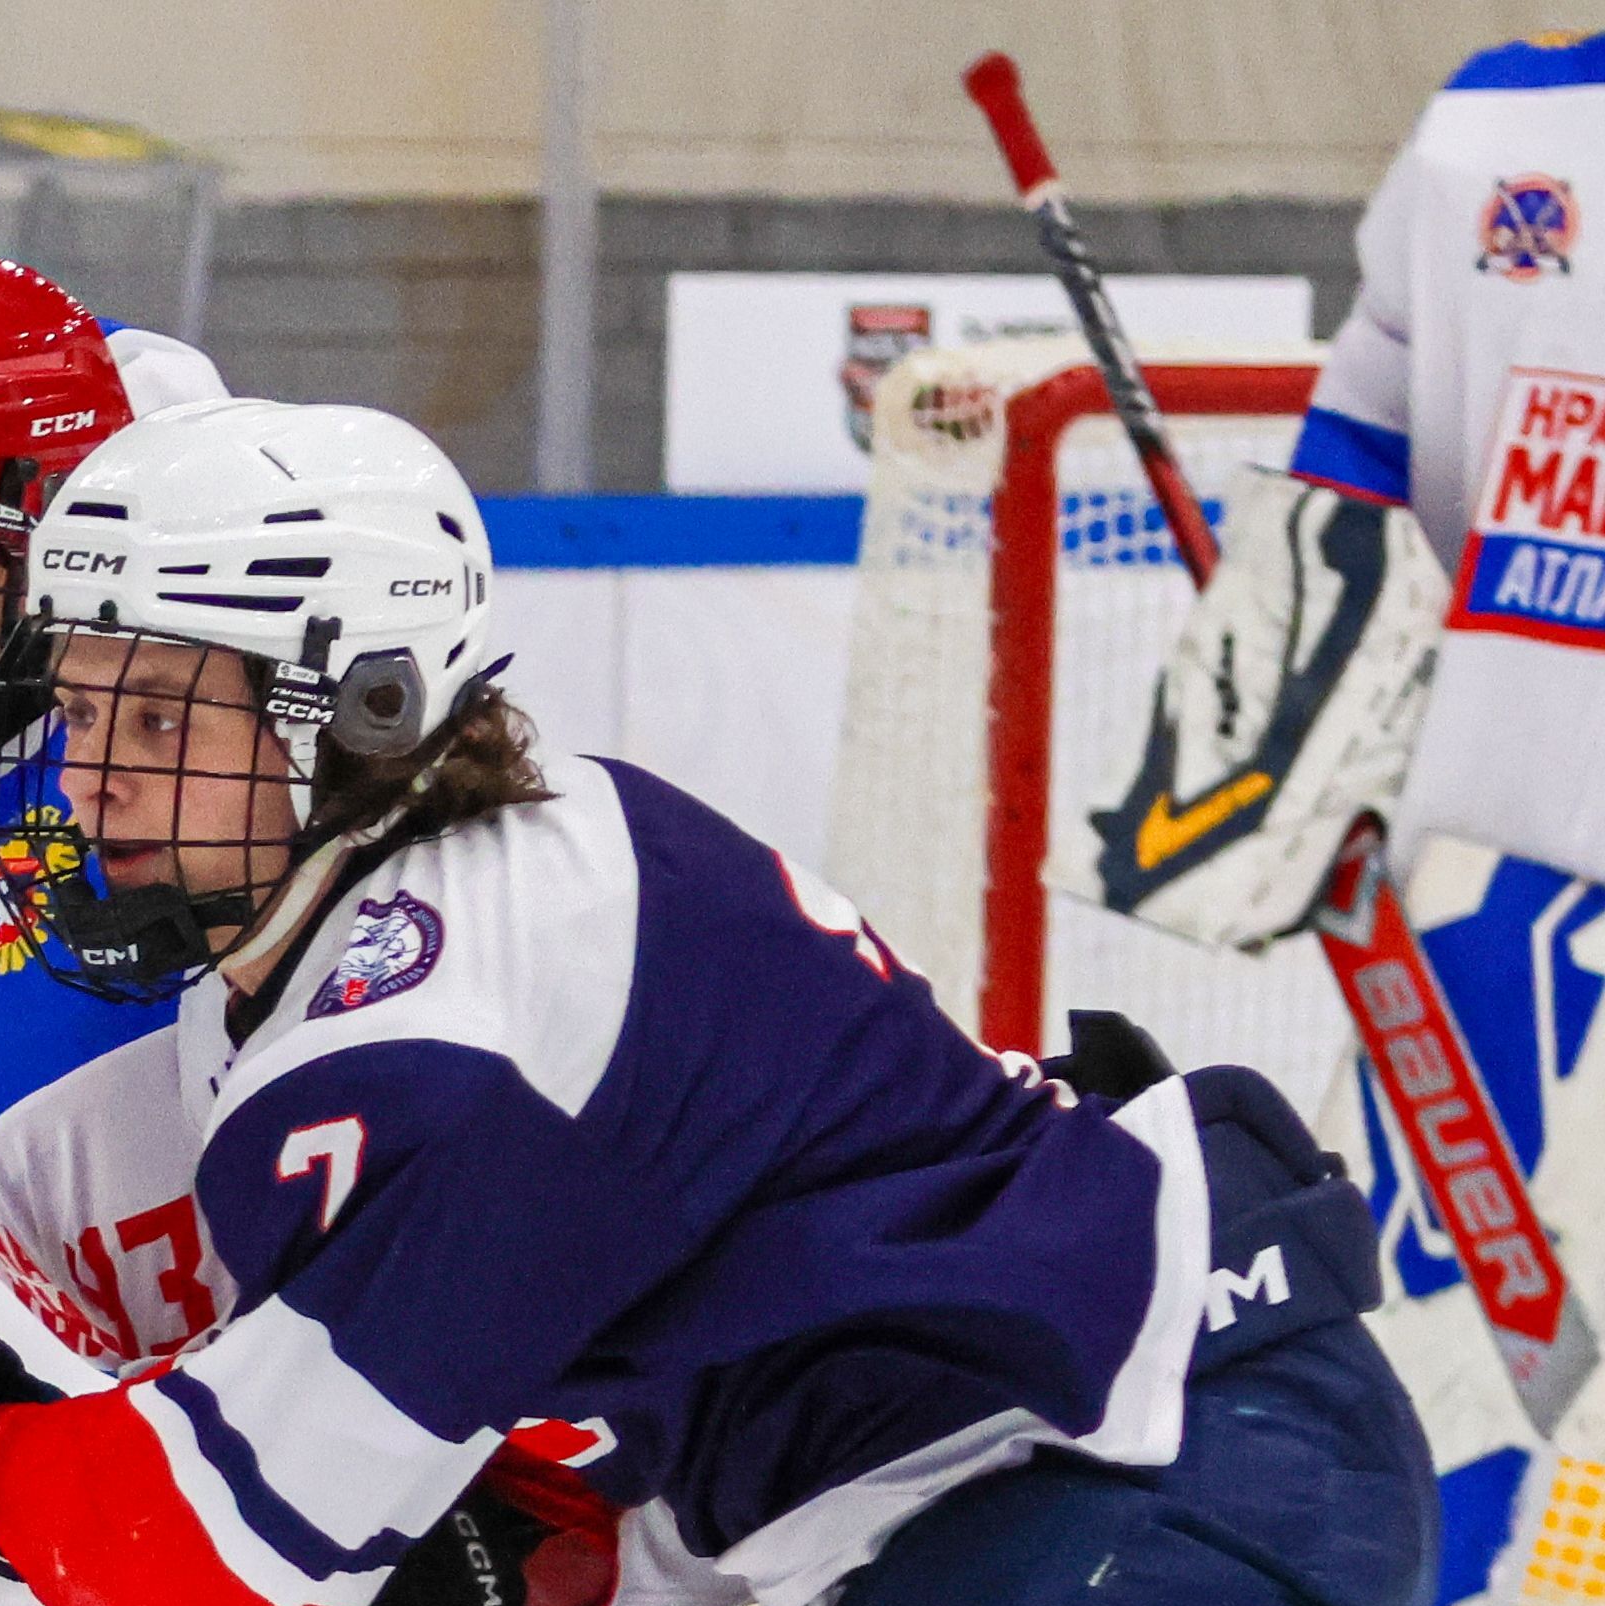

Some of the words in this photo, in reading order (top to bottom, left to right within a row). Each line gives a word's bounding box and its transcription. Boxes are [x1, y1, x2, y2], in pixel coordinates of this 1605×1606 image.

[29, 408, 96, 438] CCM
[1492, 444, 1605, 537] МА
[42, 547, 127, 576] CCM
[389, 577, 454, 599] CCM
[1495, 543, 1605, 623] АТЛ
[264, 698, 335, 726] CCM
[79, 942, 140, 967] CM
[1351, 960, 1549, 1308] BAUER
[274, 1113, 368, 1234] 7
